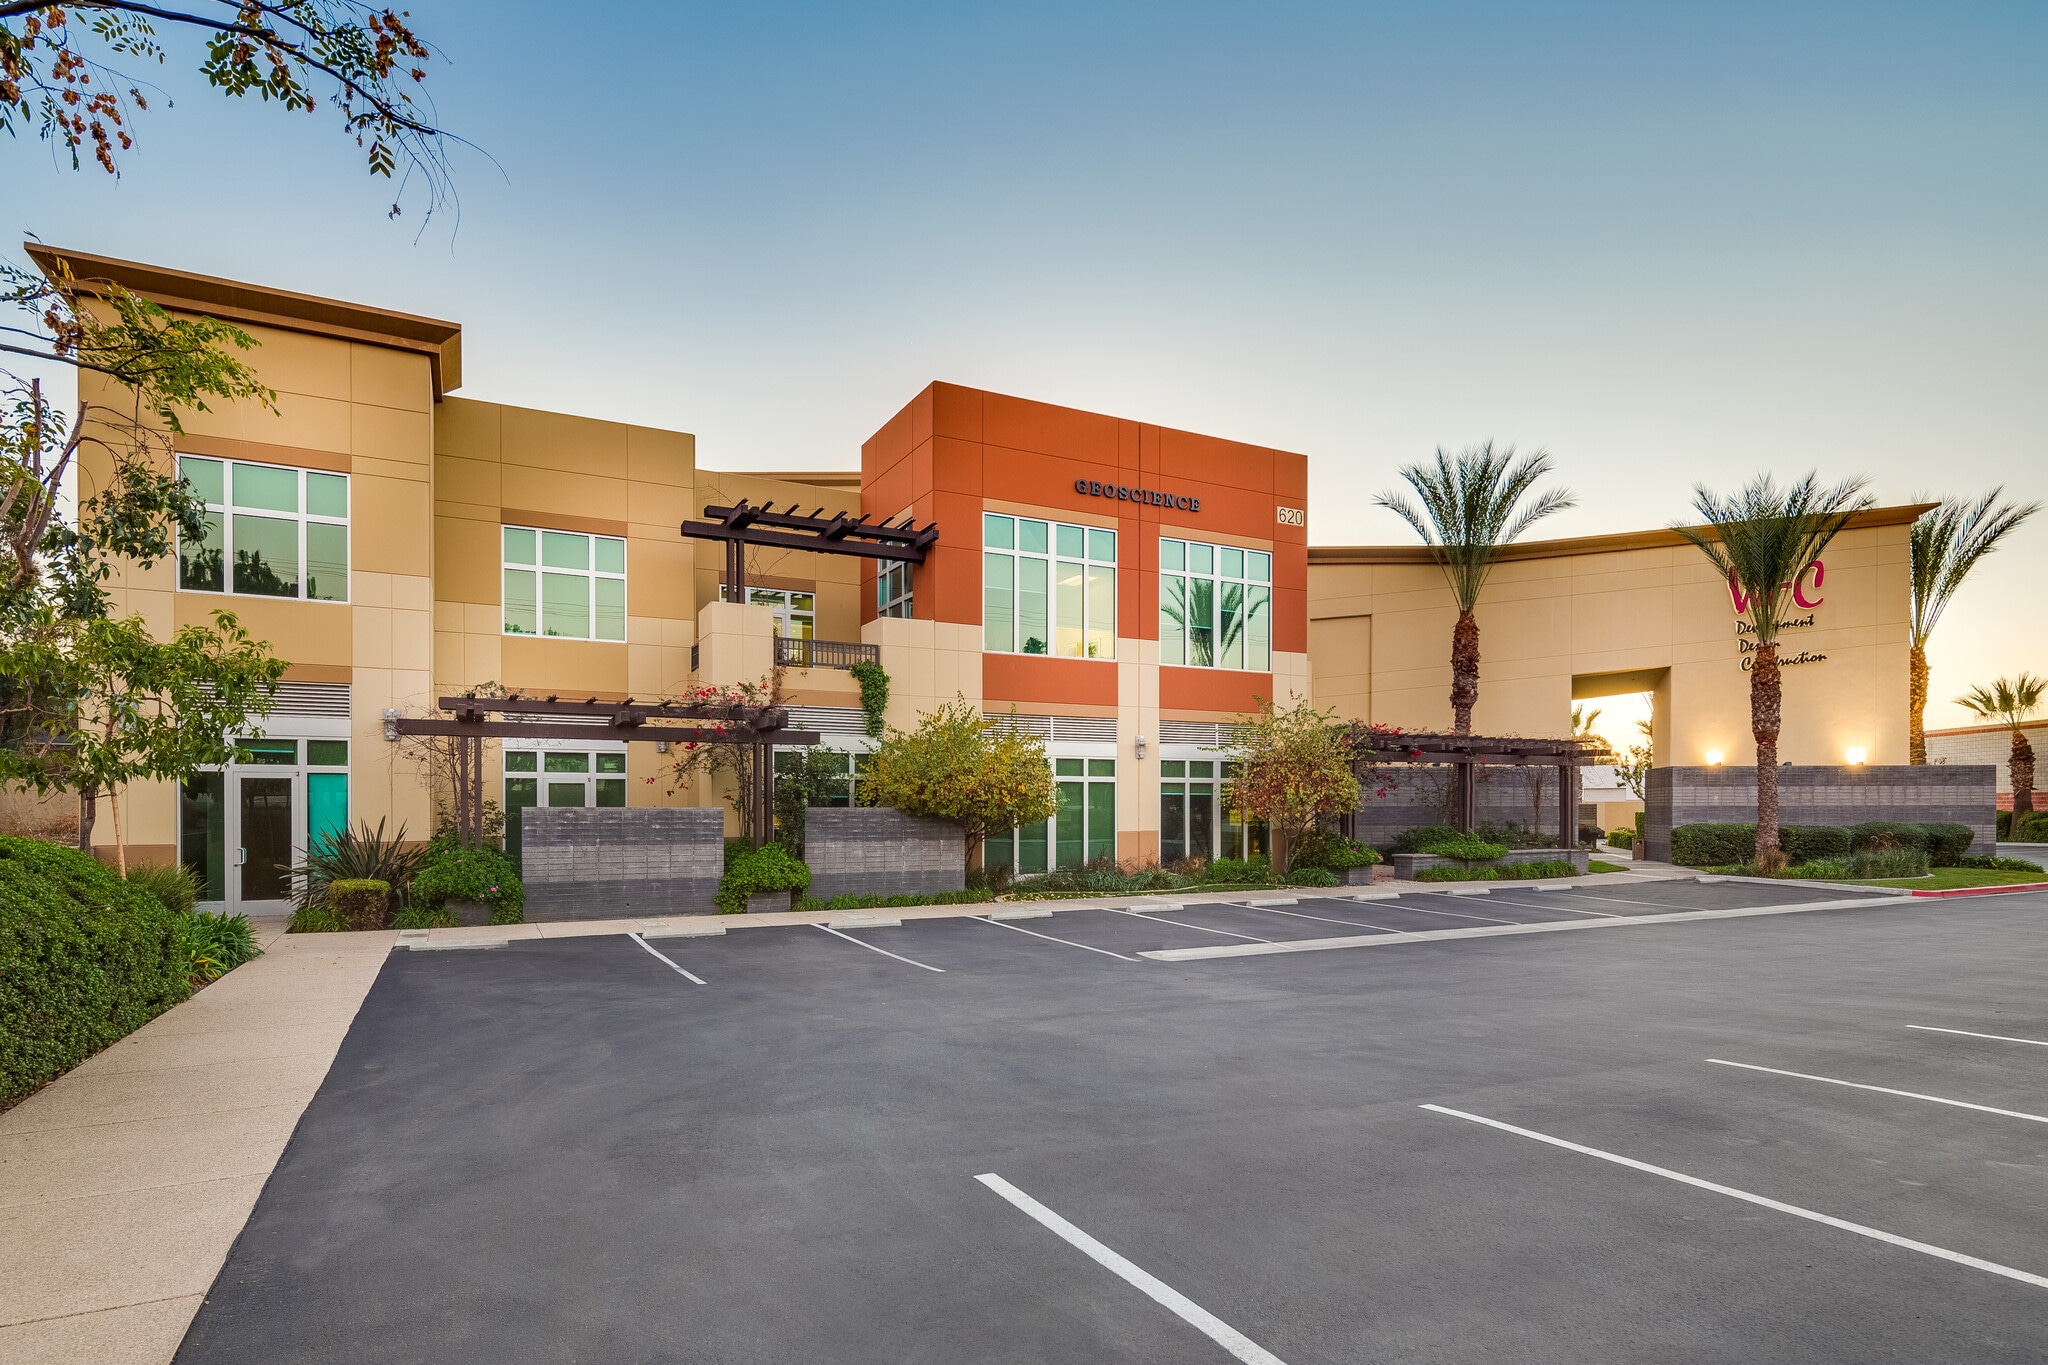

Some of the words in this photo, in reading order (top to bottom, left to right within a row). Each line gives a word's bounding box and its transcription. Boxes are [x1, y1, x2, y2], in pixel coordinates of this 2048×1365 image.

[1075, 479, 1200, 512] GEOSCIENCE
[1278, 508, 1303, 525] 620
[1735, 614, 1815, 635] Devpment
[1738, 638, 1781, 653] Desn
